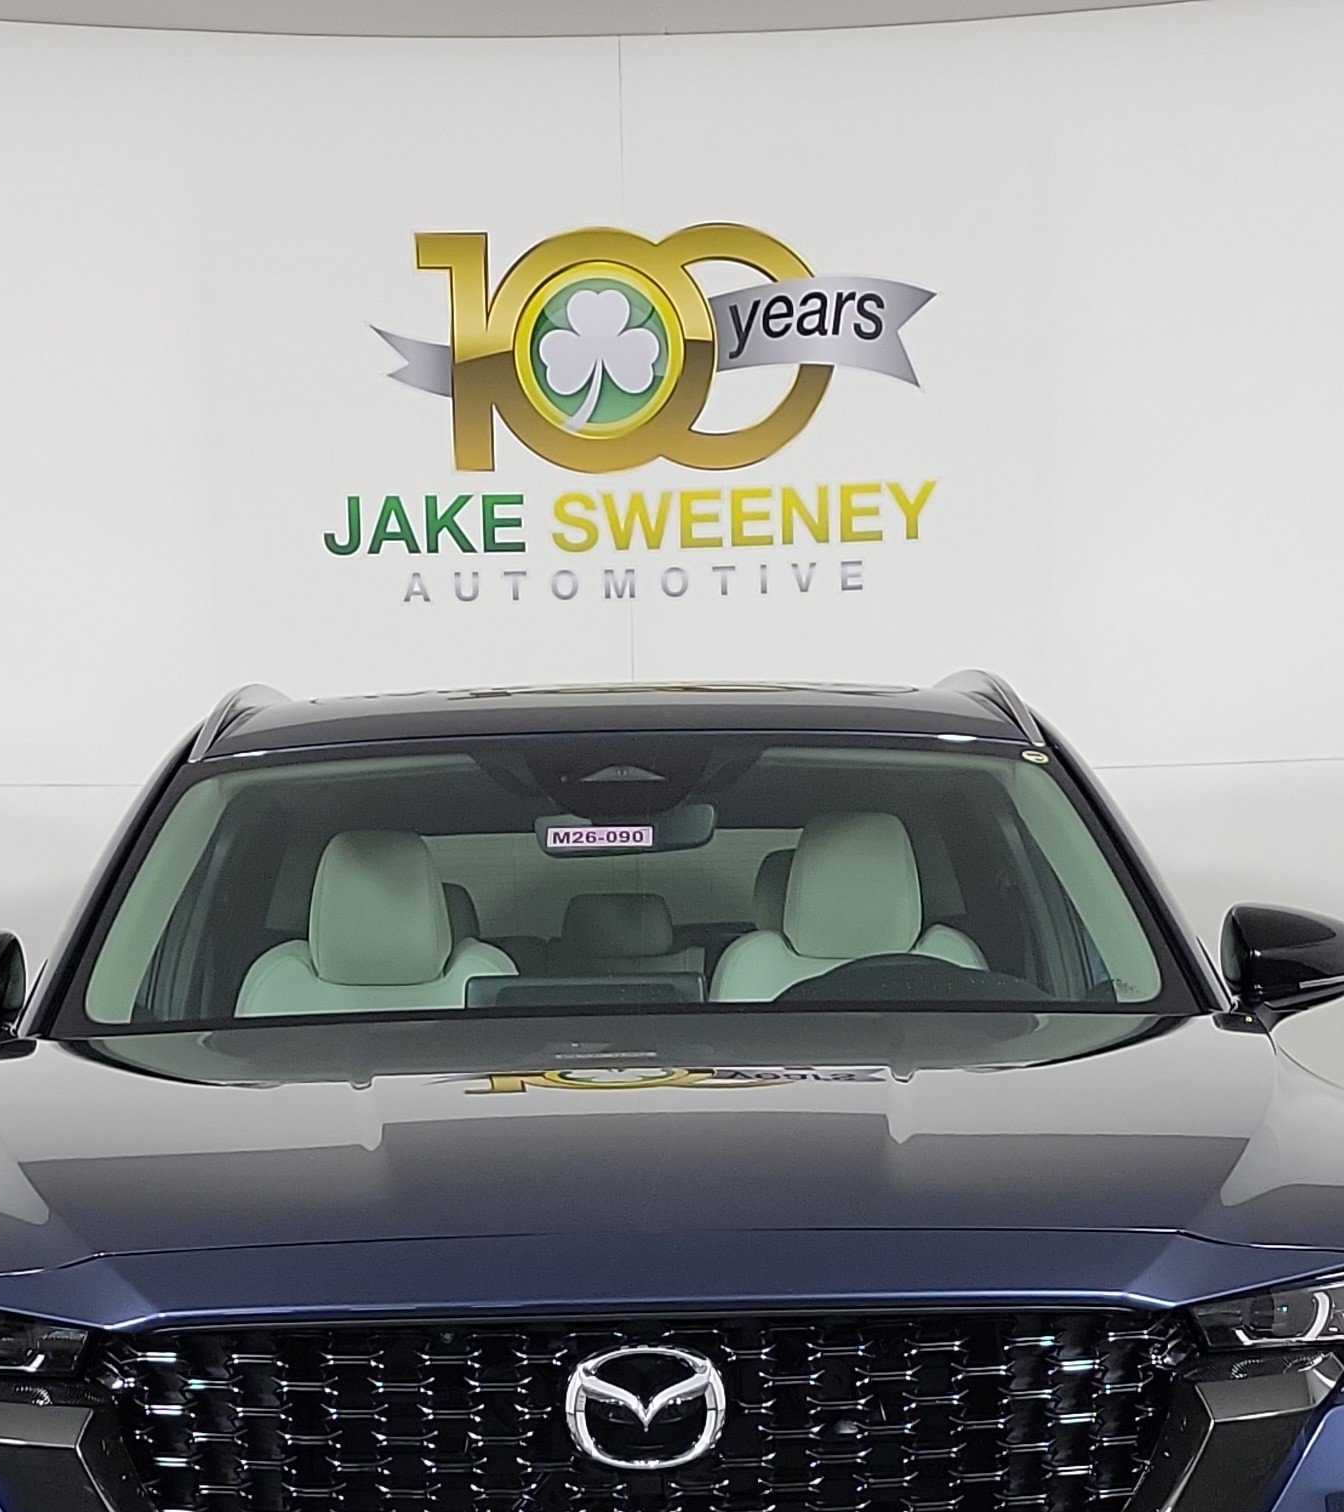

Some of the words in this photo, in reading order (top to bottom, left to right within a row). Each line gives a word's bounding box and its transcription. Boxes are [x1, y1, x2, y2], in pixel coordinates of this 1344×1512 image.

[414, 222, 835, 473] 100
[728, 288, 885, 359] years
[323, 494, 527, 556] JAKE
[552, 480, 938, 553] SWEENEY
[403, 560, 865, 603] AUTOMOTIVE
[552, 831, 644, 844] M26-090
